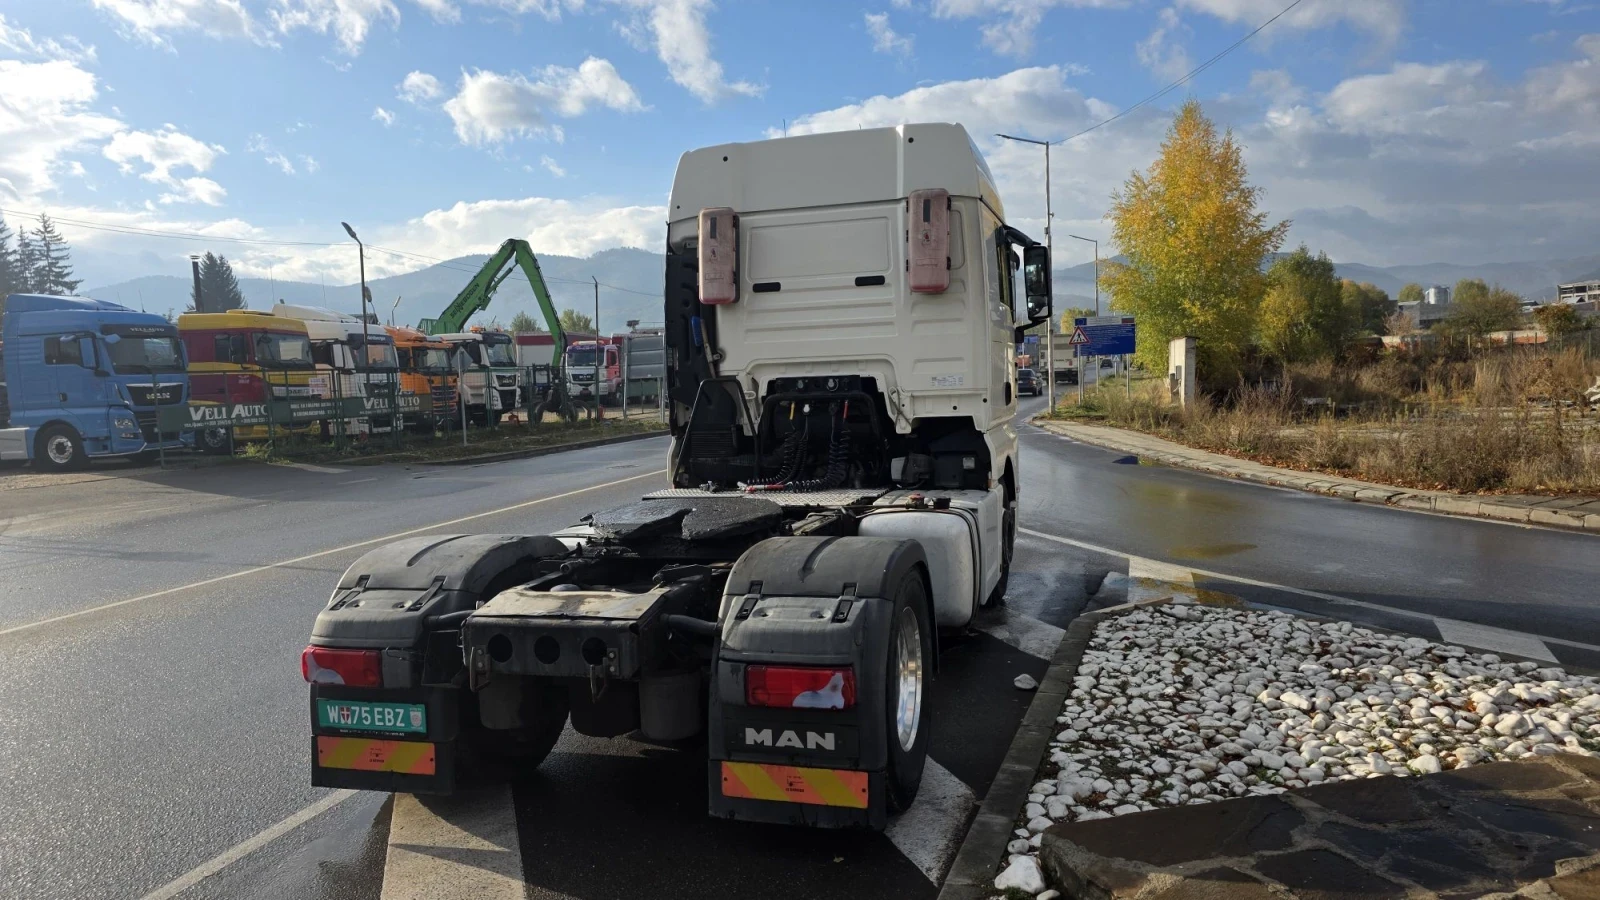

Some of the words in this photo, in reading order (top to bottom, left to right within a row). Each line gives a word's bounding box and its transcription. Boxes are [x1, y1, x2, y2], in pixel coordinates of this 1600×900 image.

[363, 397, 389, 410] VELI
[189, 406, 227, 421] VELI
[745, 727, 835, 751] MAN
